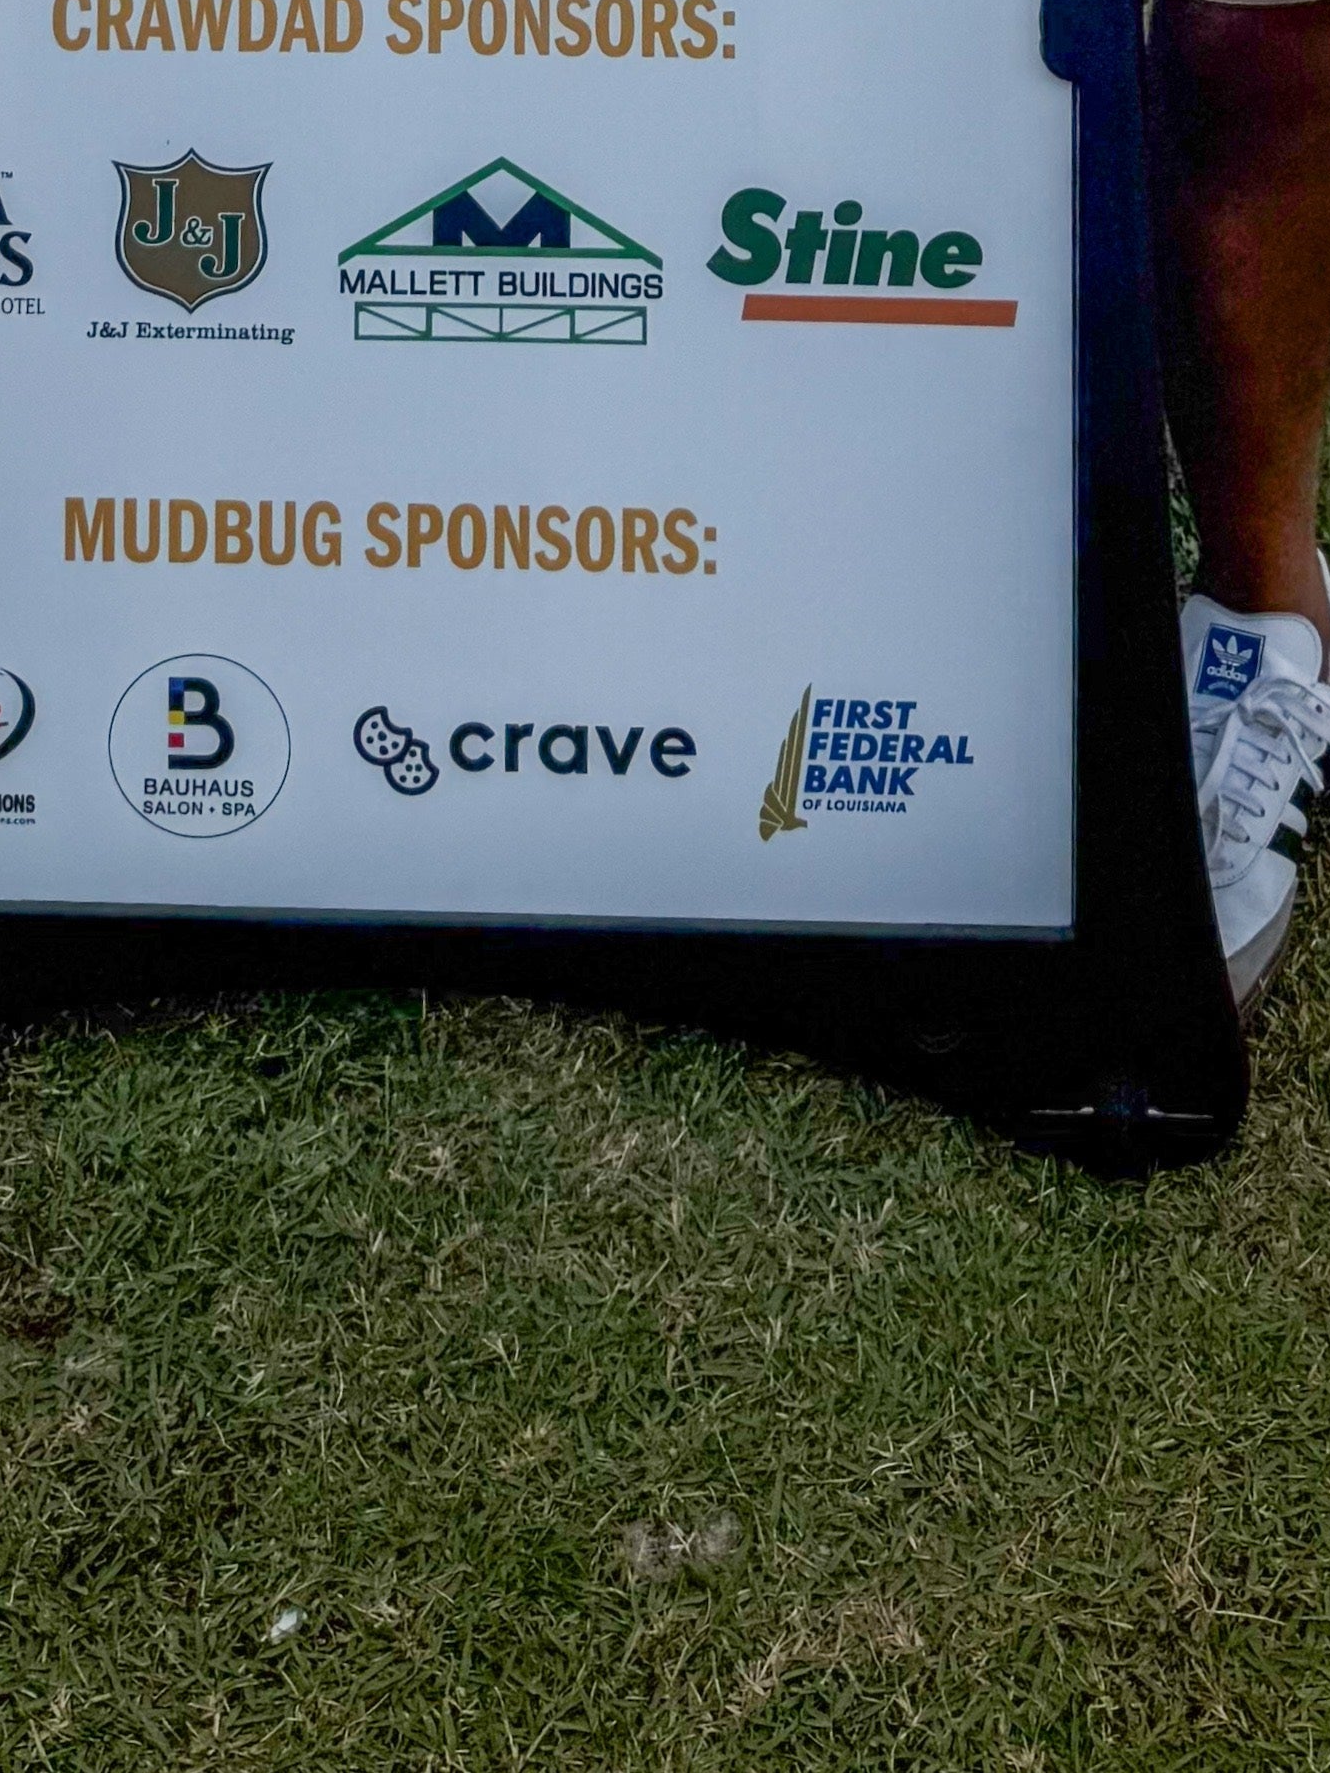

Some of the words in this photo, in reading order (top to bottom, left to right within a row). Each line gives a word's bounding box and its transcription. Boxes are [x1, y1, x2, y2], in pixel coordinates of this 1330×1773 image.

[706, 188, 985, 291] Stine
[340, 269, 487, 298] MALLETT
[499, 271, 665, 301] BUILDINGS
[87, 322, 130, 340] J&J
[137, 322, 297, 347] Exterminating
[65, 498, 343, 569] MUDBUG
[365, 502, 718, 576] SPONSORS:
[1207, 664, 1247, 683] adidas
[168, 677, 236, 772] B
[812, 699, 918, 731] FIRST
[450, 722, 698, 779] crave
[808, 732, 975, 765] FEDERAL
[144, 778, 255, 799] BAUHAUS
[803, 766, 920, 797] BANK
[143, 801, 204, 817] SALON
[222, 803, 257, 818] SPA
[803, 799, 823, 812] OF
[827, 800, 908, 814] LOUISIANA
